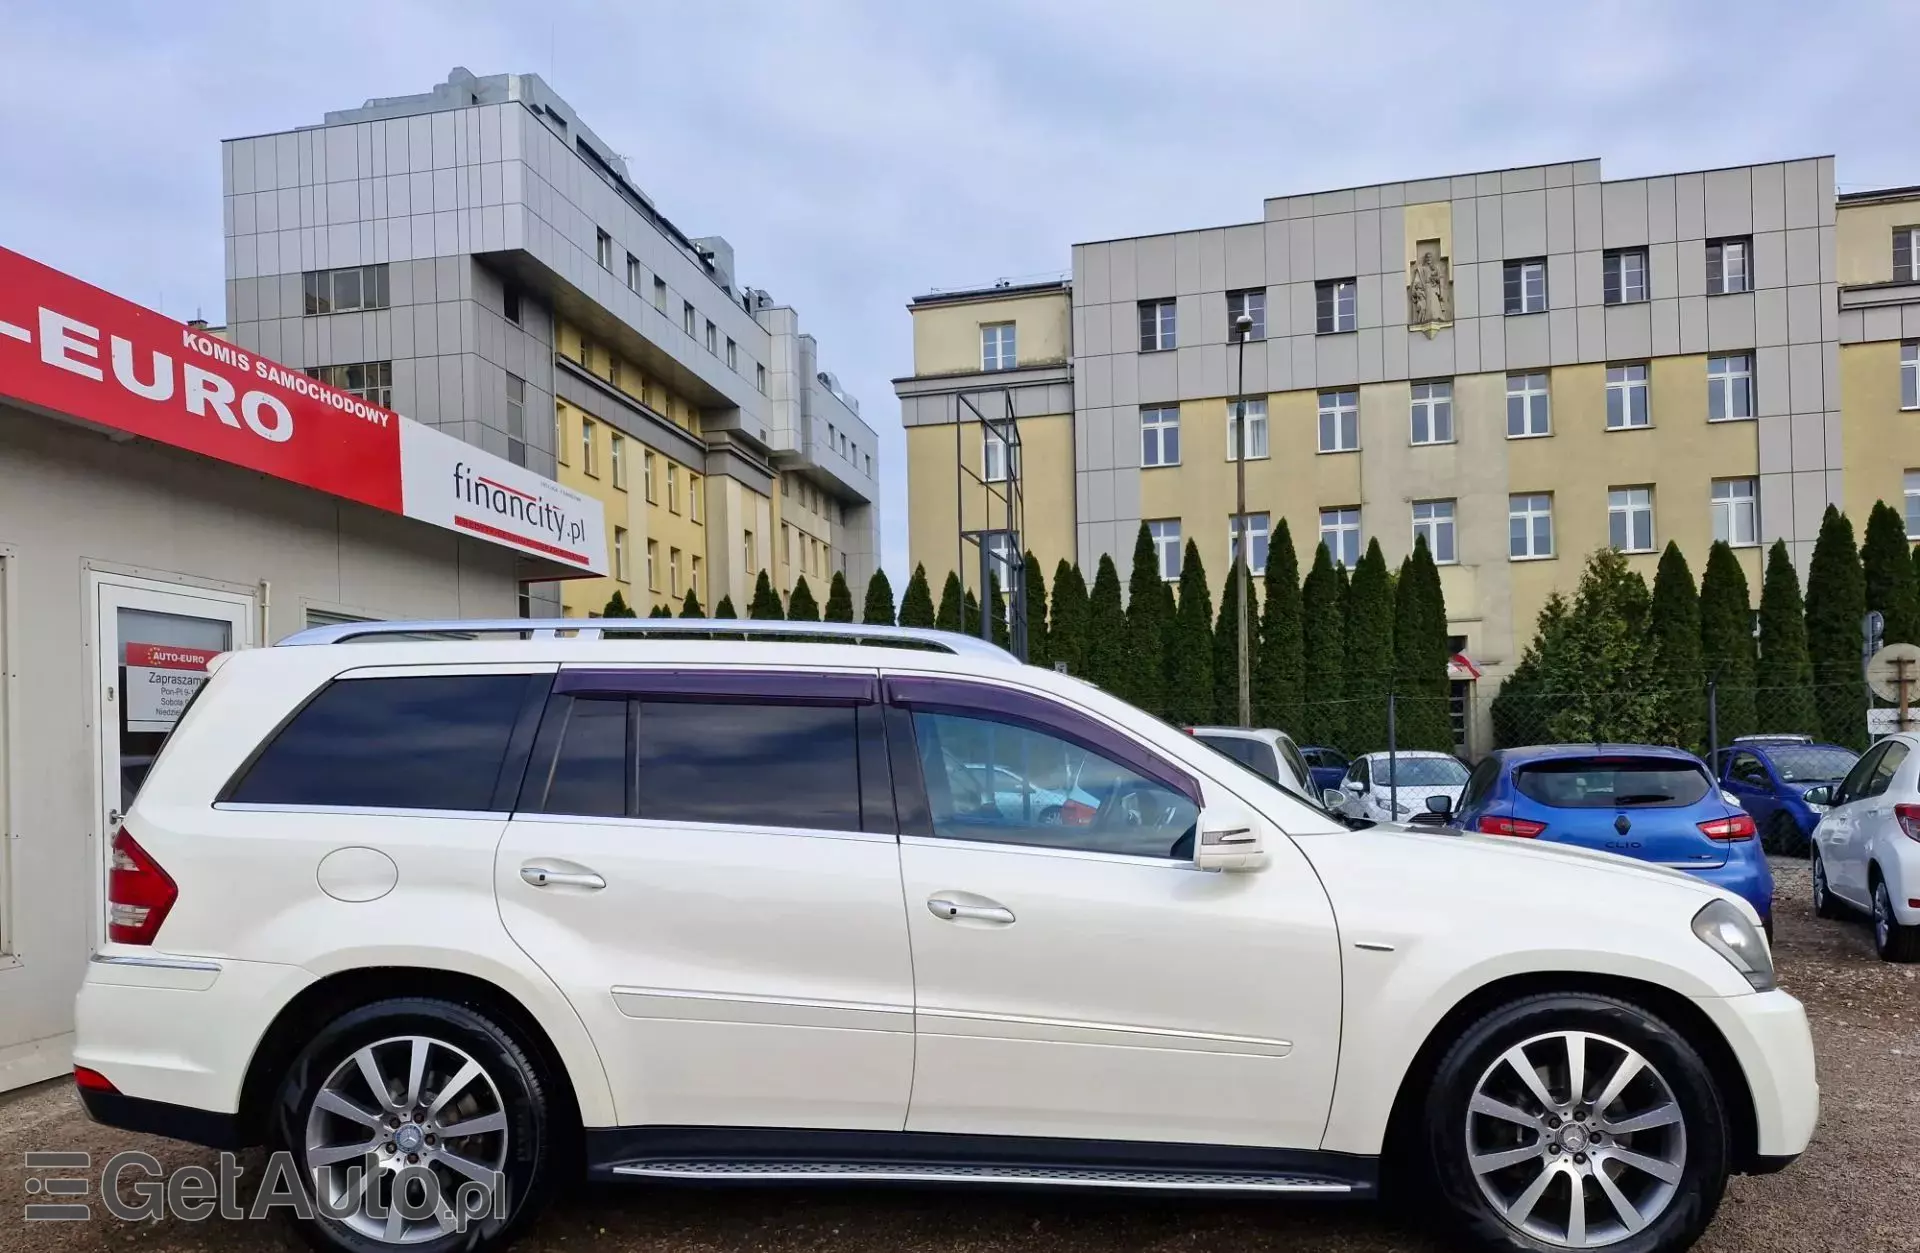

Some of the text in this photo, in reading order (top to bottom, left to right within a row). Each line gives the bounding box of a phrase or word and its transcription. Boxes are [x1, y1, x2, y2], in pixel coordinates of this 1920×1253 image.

[182, 330, 390, 428] KOMIS SAMOCHODOWY
[453, 462, 585, 545] financity.pl
[153, 651, 205, 664] AUTO-EURO
[1605, 841, 1642, 849] CLIO
